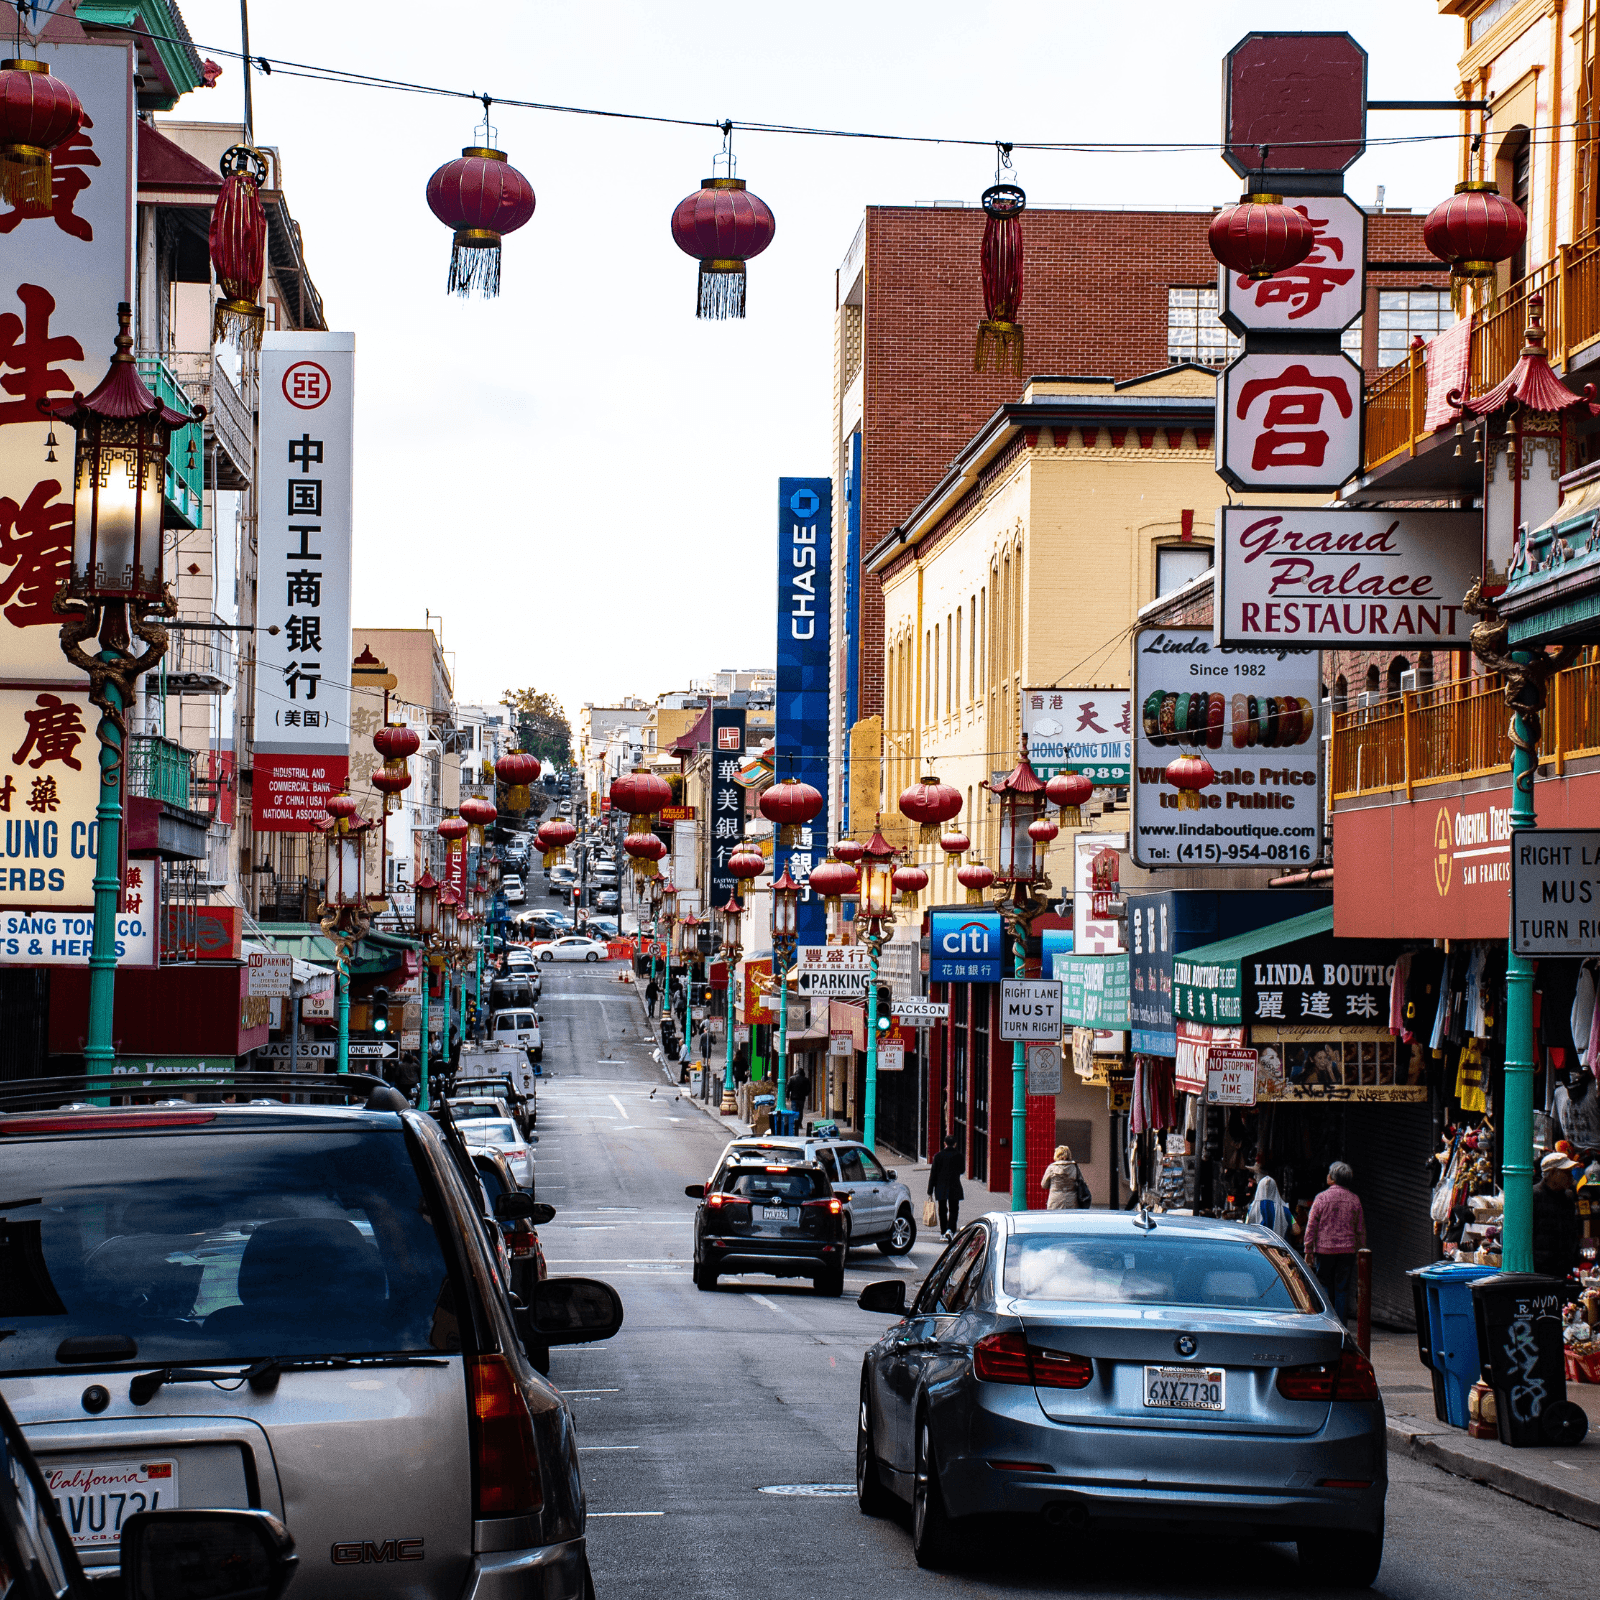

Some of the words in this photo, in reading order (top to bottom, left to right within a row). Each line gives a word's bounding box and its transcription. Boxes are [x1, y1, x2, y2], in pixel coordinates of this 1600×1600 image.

[1240, 516, 1400, 563] Grand
[285, 434, 324, 699] 中国工商银行
[791, 524, 816, 640] CHASE
[1268, 557, 1433, 595] Palace
[1241, 602, 1463, 635] RESTAURANT
[1142, 634, 1210, 654] Linda
[1190, 664, 1228, 676] Since
[1234, 665, 1266, 676] 1982
[1031, 695, 1063, 710] 香港
[275, 710, 329, 728] (美国)
[12, 694, 87, 771] 廣
[1032, 742, 1063, 758] HONG
[1067, 742, 1098, 758] KONG
[1101, 742, 1121, 758] DIM
[273, 767, 309, 778] INDUSTRIAL
[312, 768, 325, 778] AND
[1259, 768, 1316, 785] Price
[269, 781, 310, 792] COMMERCIAL
[313, 782, 331, 792] BANK
[274, 795, 283, 805] OF
[286, 796, 305, 806] CHINA
[1159, 792, 1179, 809] to
[1226, 791, 1295, 809] Public
[263, 809, 293, 819] NATIONAL
[296, 809, 330, 820] ASSOCIATI
[1139, 824, 1316, 839] www.lindaboutique.com
[1455, 811, 1488, 847] ORIENTAL
[0, 820, 58, 858] UNG
[790, 819, 813, 902] 通銀行
[1148, 848, 1170, 859] Tel:
[1177, 843, 1311, 862] (415)-954-0816
[1520, 846, 1572, 865] RIGHT
[1463, 865, 1477, 885] SAN
[7, 918, 56, 935] SANG
[63, 919, 95, 935] TON
[118, 920, 146, 936] CO.
[1520, 919, 1568, 938] TURN
[28, 939, 43, 955] &
[52, 939, 126, 957] HERS
[943, 928, 989, 953] citi
[250, 955, 262, 966] NO
[263, 957, 290, 967] PARKING
[805, 949, 866, 963] 豐盛行
[251, 969, 257, 977] 2
[274, 969, 279, 977] 6
[942, 965, 991, 976] 花旗銀行
[1173, 962, 1191, 985] LINDA
[1192, 965, 1220, 989] BOUTIQUE
[1254, 964, 1315, 986] LINDA
[811, 974, 870, 989] PARKING
[1004, 988, 1031, 999] RIGHT
[1034, 989, 1059, 999] LANE
[890, 1005, 946, 1015] JACKSON
[1008, 1004, 1054, 1016] MUST
[1254, 991, 1379, 1019] 麗達珠
[1004, 1021, 1028, 1032] TURN
[1032, 1022, 1059, 1032] RIGHT
[260, 1044, 331, 1056] JACSON
[351, 1046, 365, 1054] ONE
[367, 1046, 382, 1054] WAY
[1213, 1049, 1253, 1058] TOW-AWAY
[1209, 1057, 1222, 1070] NO
[1223, 1060, 1254, 1072] STOPPING
[1221, 1072, 1241, 1083] ANY
[1220, 1083, 1242, 1095] TIME
[1149, 1380, 1220, 1403] 6XXZ730
[1149, 1399, 1172, 1407] AUDI
[1173, 1401, 1222, 1410] CONCORD
[49, 1469, 149, 1493] California
[331, 1537, 425, 1564] GMC
